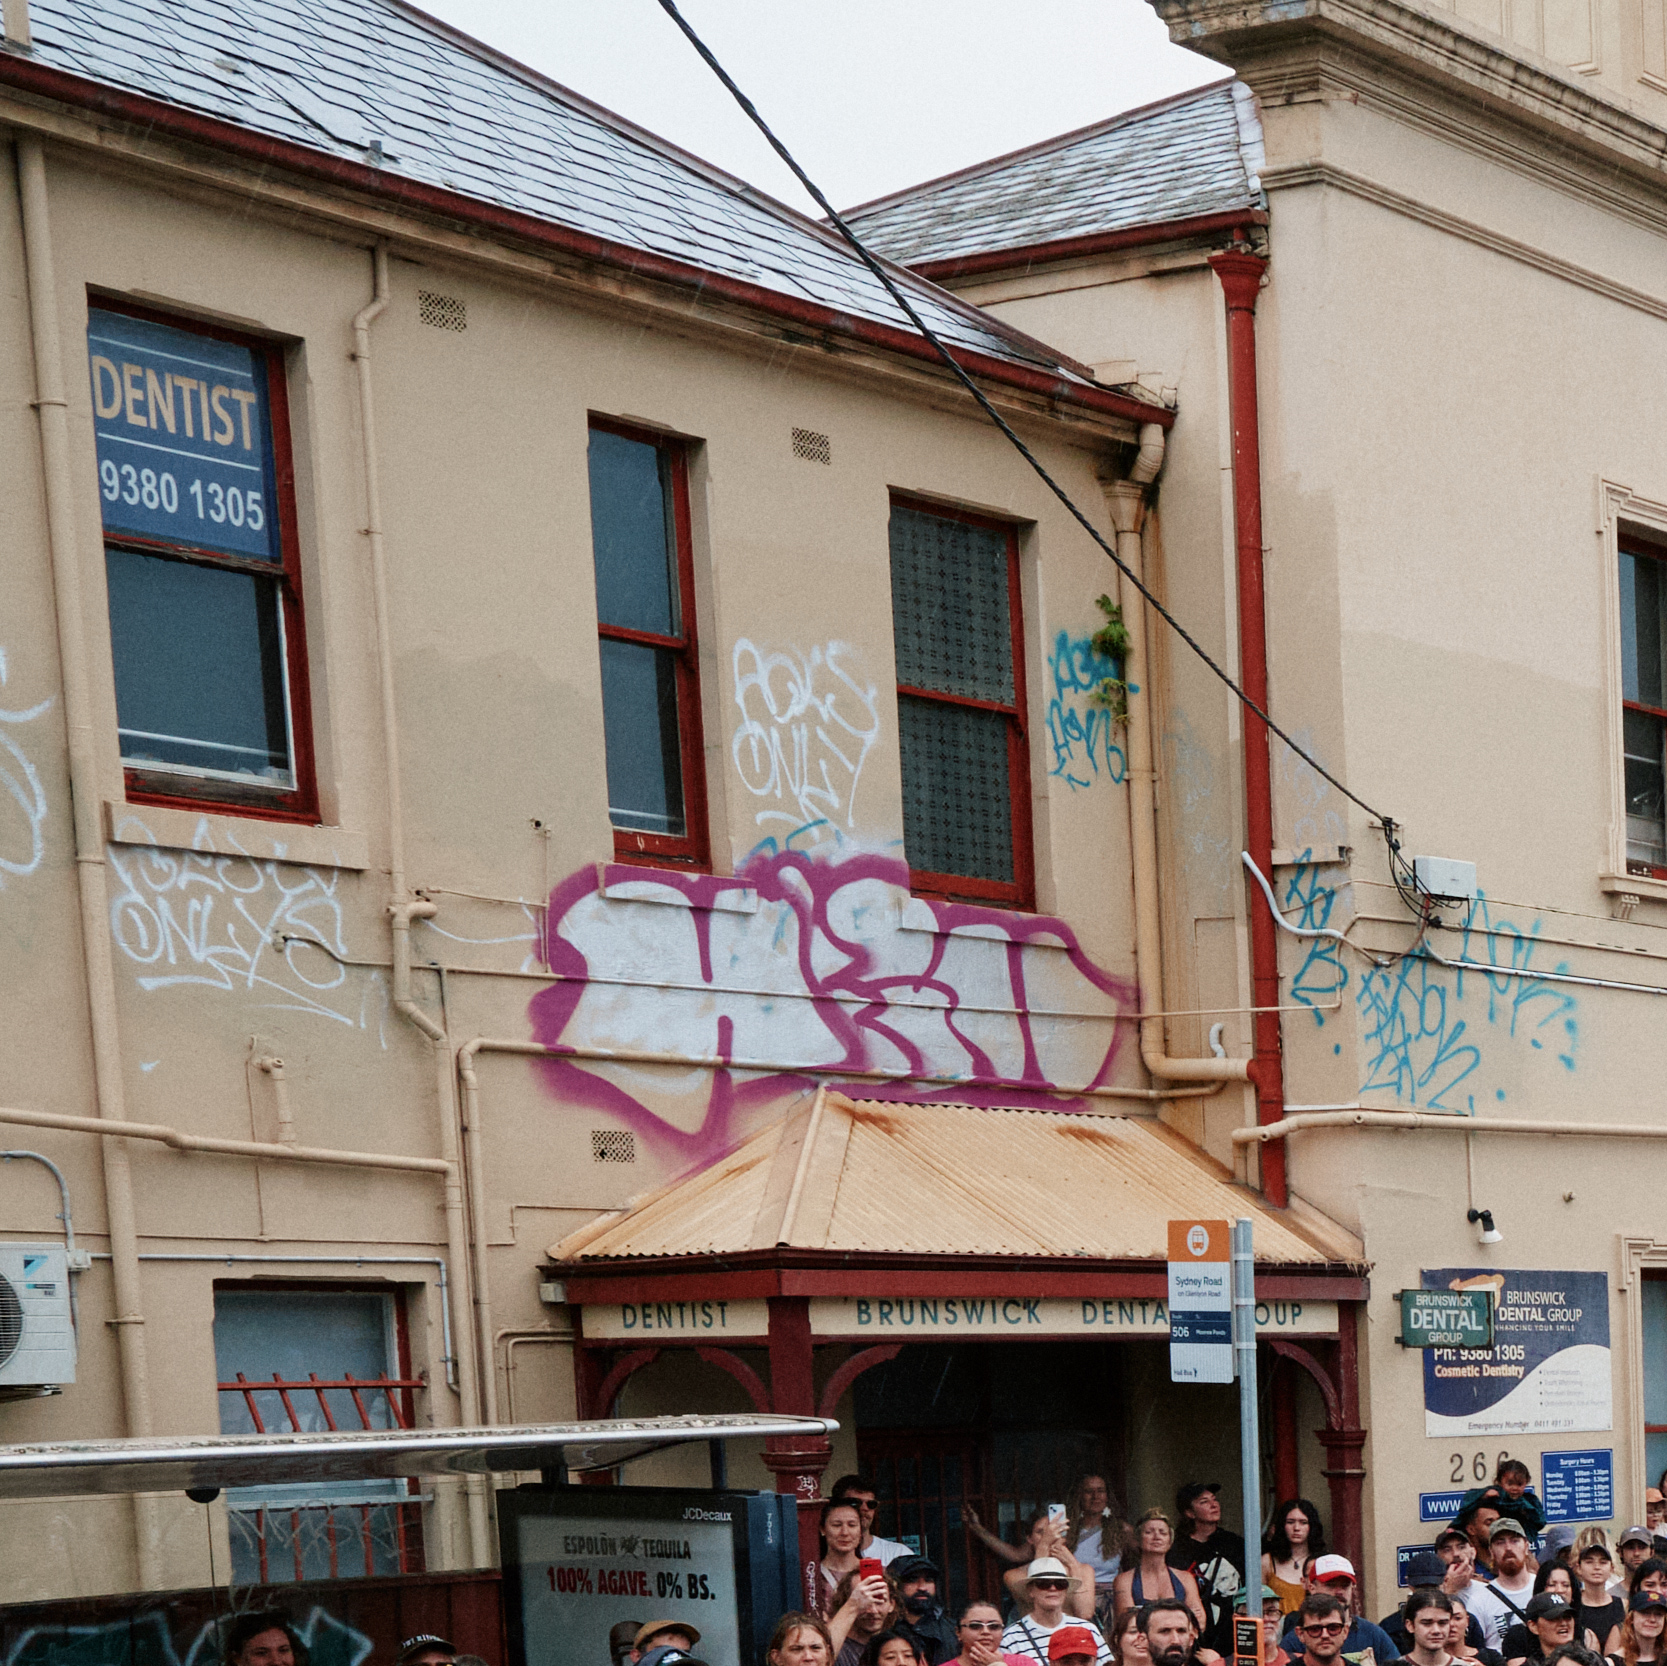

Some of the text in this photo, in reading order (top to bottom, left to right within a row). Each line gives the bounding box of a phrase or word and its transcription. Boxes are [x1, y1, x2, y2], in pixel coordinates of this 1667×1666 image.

[92, 354, 257, 451] DENTIST
[100, 459, 264, 531] 9380 1305
[1175, 1276, 1223, 1288] Sydney Road
[1415, 1295, 1473, 1307] BRUNSWICK
[1507, 1290, 1566, 1305] BRUNSWICK
[622, 1301, 728, 1328] DENTIST
[858, 1299, 1043, 1326] BRUNSWICK
[1083, 1299, 1169, 1325] DENTA
[1410, 1308, 1484, 1331] DENTAL
[1498, 1306, 1583, 1322] DENTAL GROUP
[1172, 1326, 1190, 1338] 506
[1428, 1331, 1464, 1343] GROUP
[1460, 1349, 1492, 1361] 9380
[1494, 1345, 1525, 1361] 1305
[1434, 1363, 1525, 1379] Cosmetic Dentistry
[682, 1506, 733, 1522] JCDecaux
[642, 1539, 692, 1561] TEQUILA
[1398, 1552, 1410, 1563] DR
[546, 1565, 716, 1601] 100% AGAVE. 0% BS.
